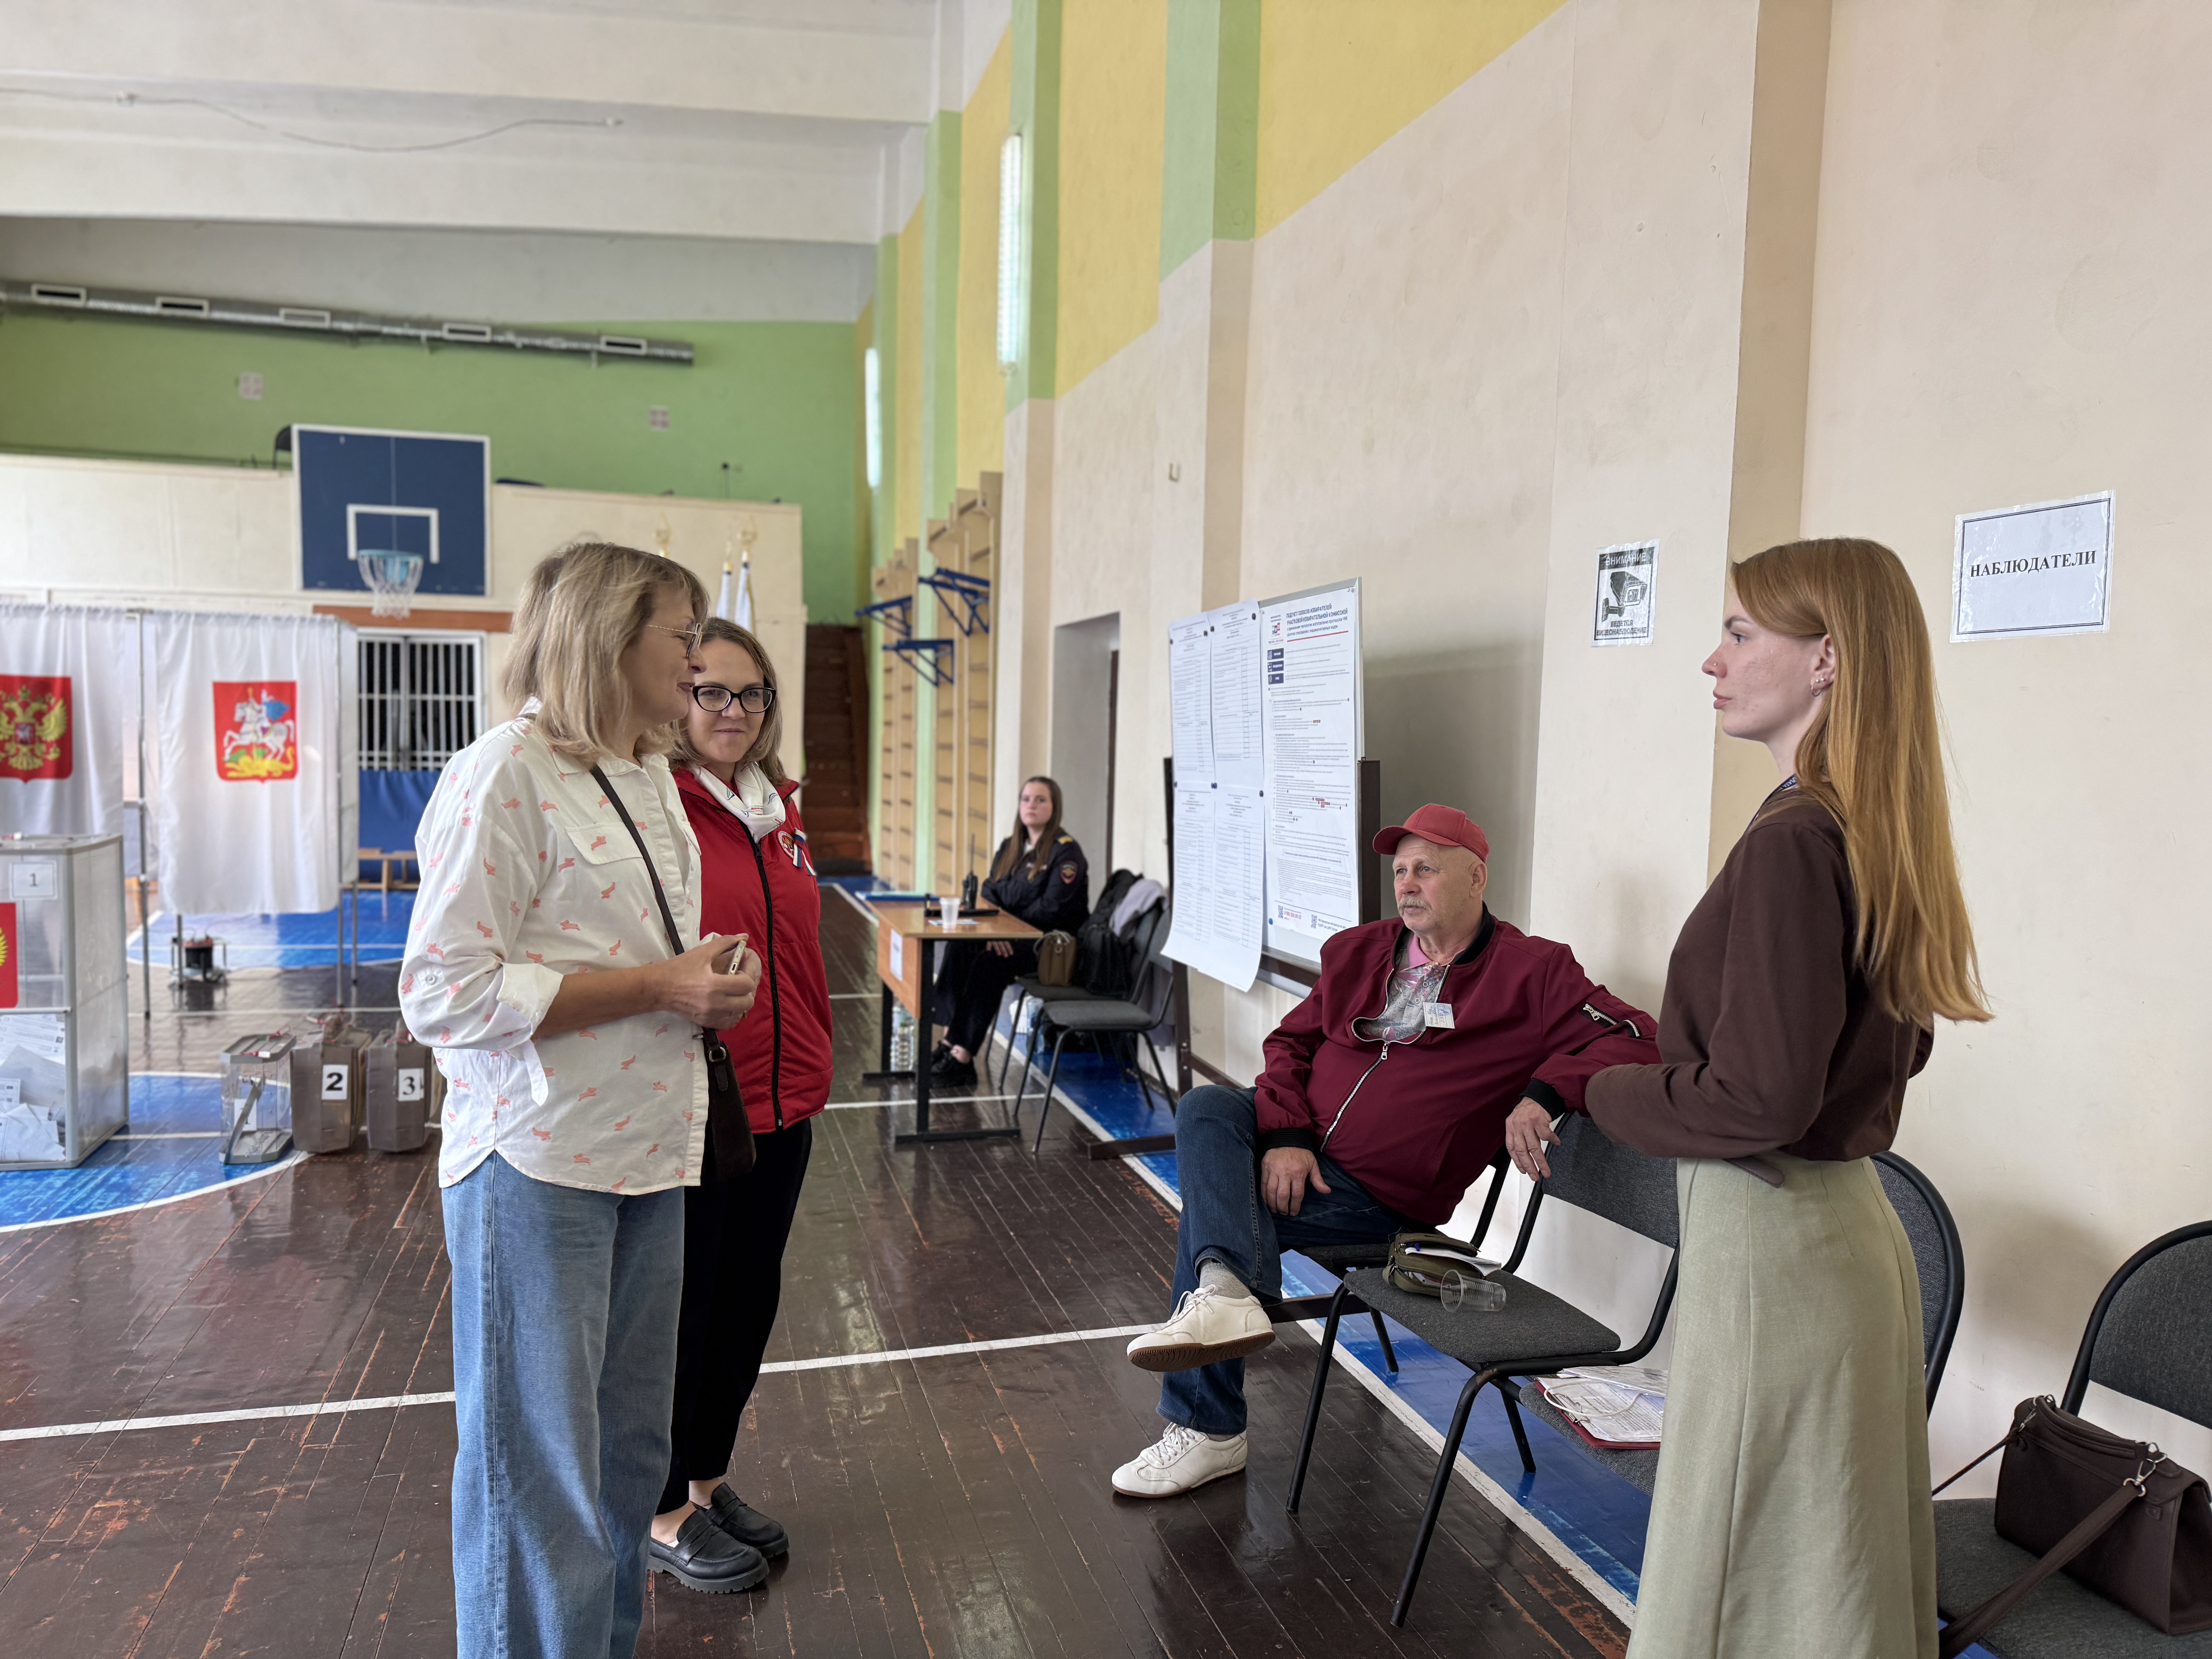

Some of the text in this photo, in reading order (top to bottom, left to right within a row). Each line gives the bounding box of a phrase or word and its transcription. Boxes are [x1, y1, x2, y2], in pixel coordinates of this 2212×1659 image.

[1606, 552, 1646, 566] ВНИМАНИЕ
[1970, 550, 2097, 577] НАБЛЮДАТЕЛИ
[1597, 627, 1647, 636] ВИДЕОНАБЛЮДЕНИЕ
[1611, 620, 1633, 628] ВЕДЕТСЯ
[29, 872, 39, 887] 1
[326, 1072, 343, 1091] 2
[403, 1077, 415, 1095] 3
